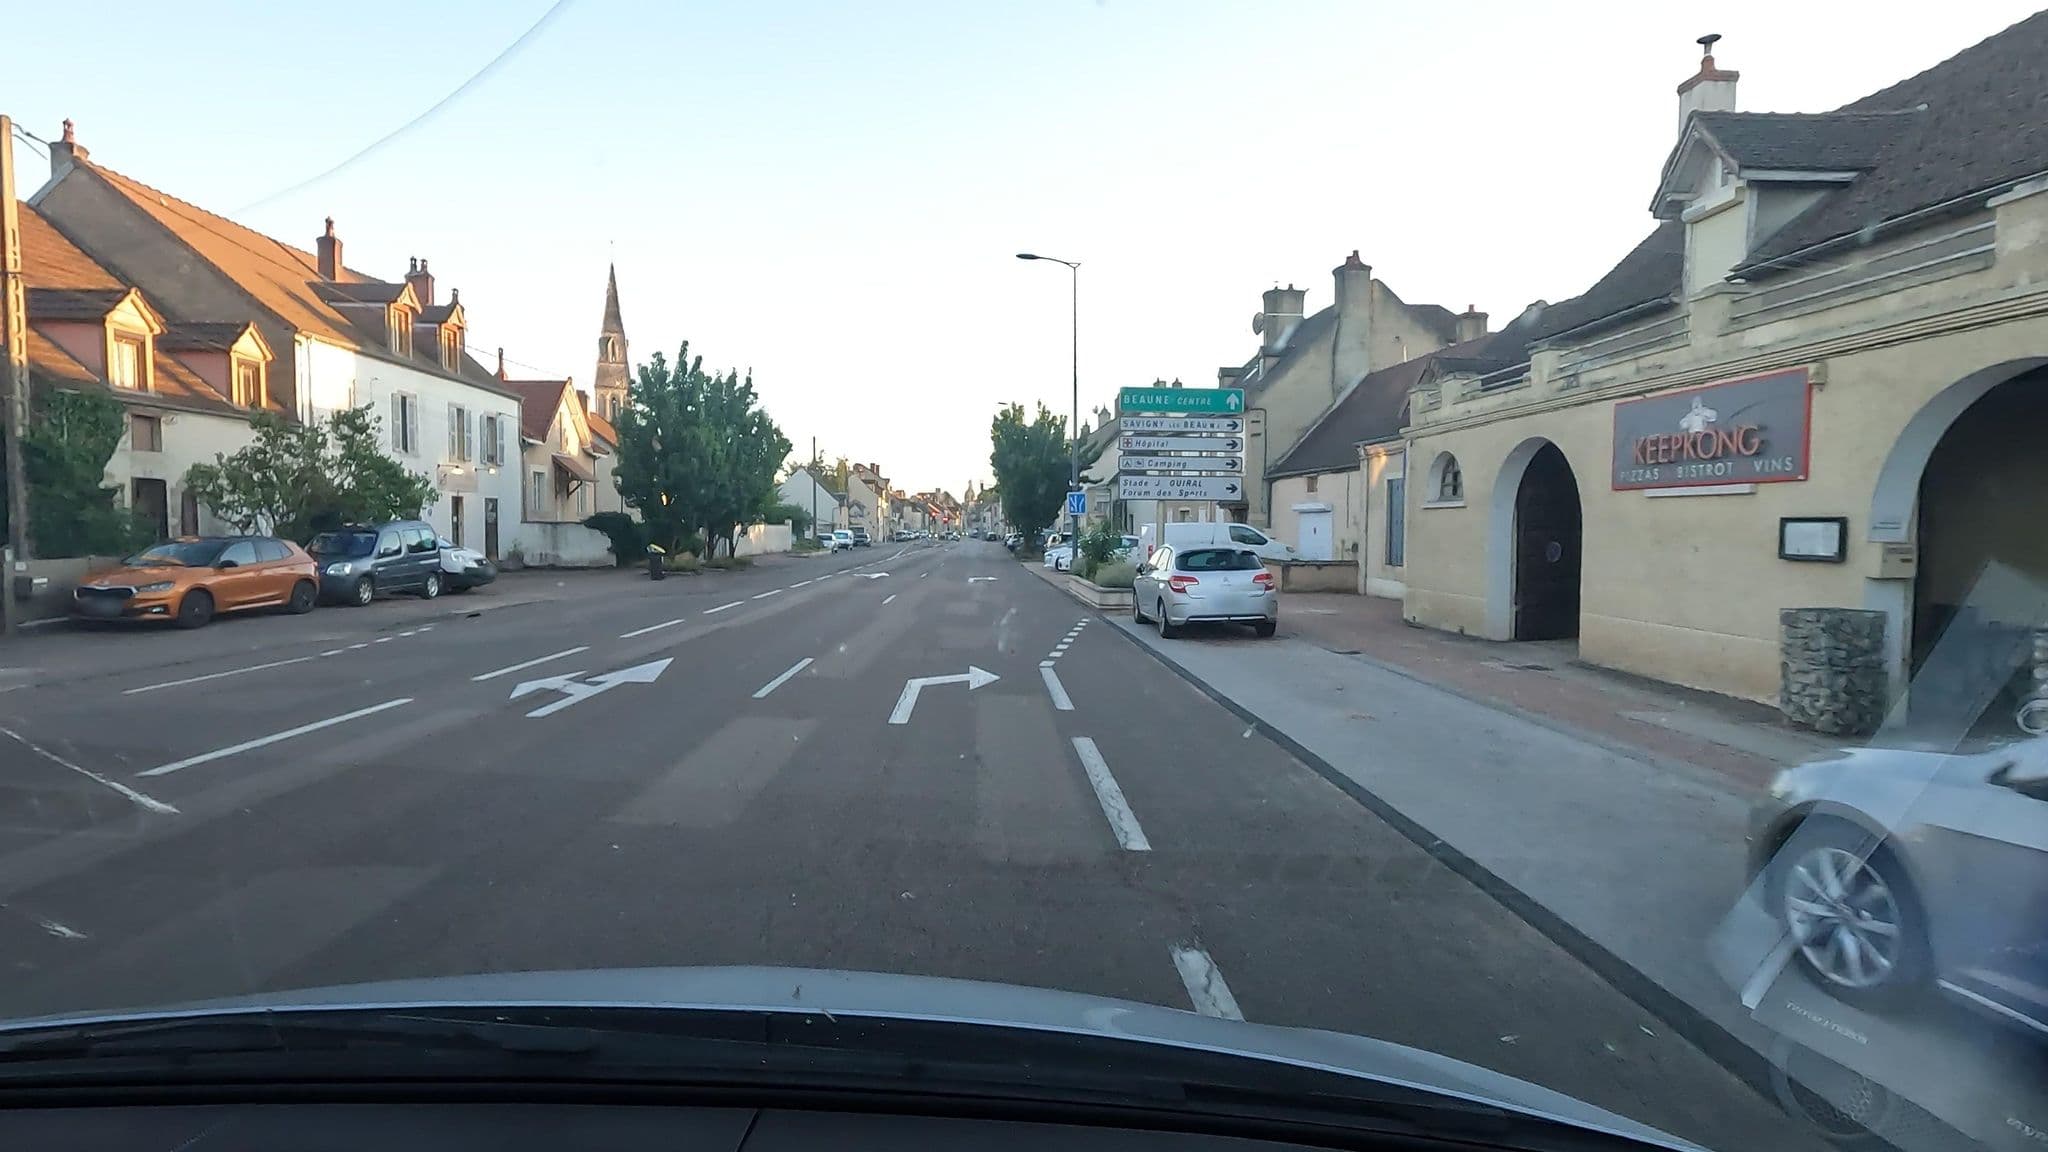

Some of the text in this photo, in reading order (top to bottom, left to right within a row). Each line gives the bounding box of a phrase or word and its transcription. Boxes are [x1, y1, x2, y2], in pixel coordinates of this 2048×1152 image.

[1123, 395, 1212, 405] BEAUNE CENTRE
[1123, 420, 1164, 428] SAVIGNY
[1135, 438, 1169, 448] Hôpital
[1633, 425, 1760, 465] KEEPKONG
[1148, 460, 1187, 468] Camping
[1619, 457, 1793, 482] PIZZAS BISTROT VINS
[1123, 479, 1148, 487] Stade
[1123, 488, 1151, 496] Forum
[1179, 489, 1208, 497] Sports
